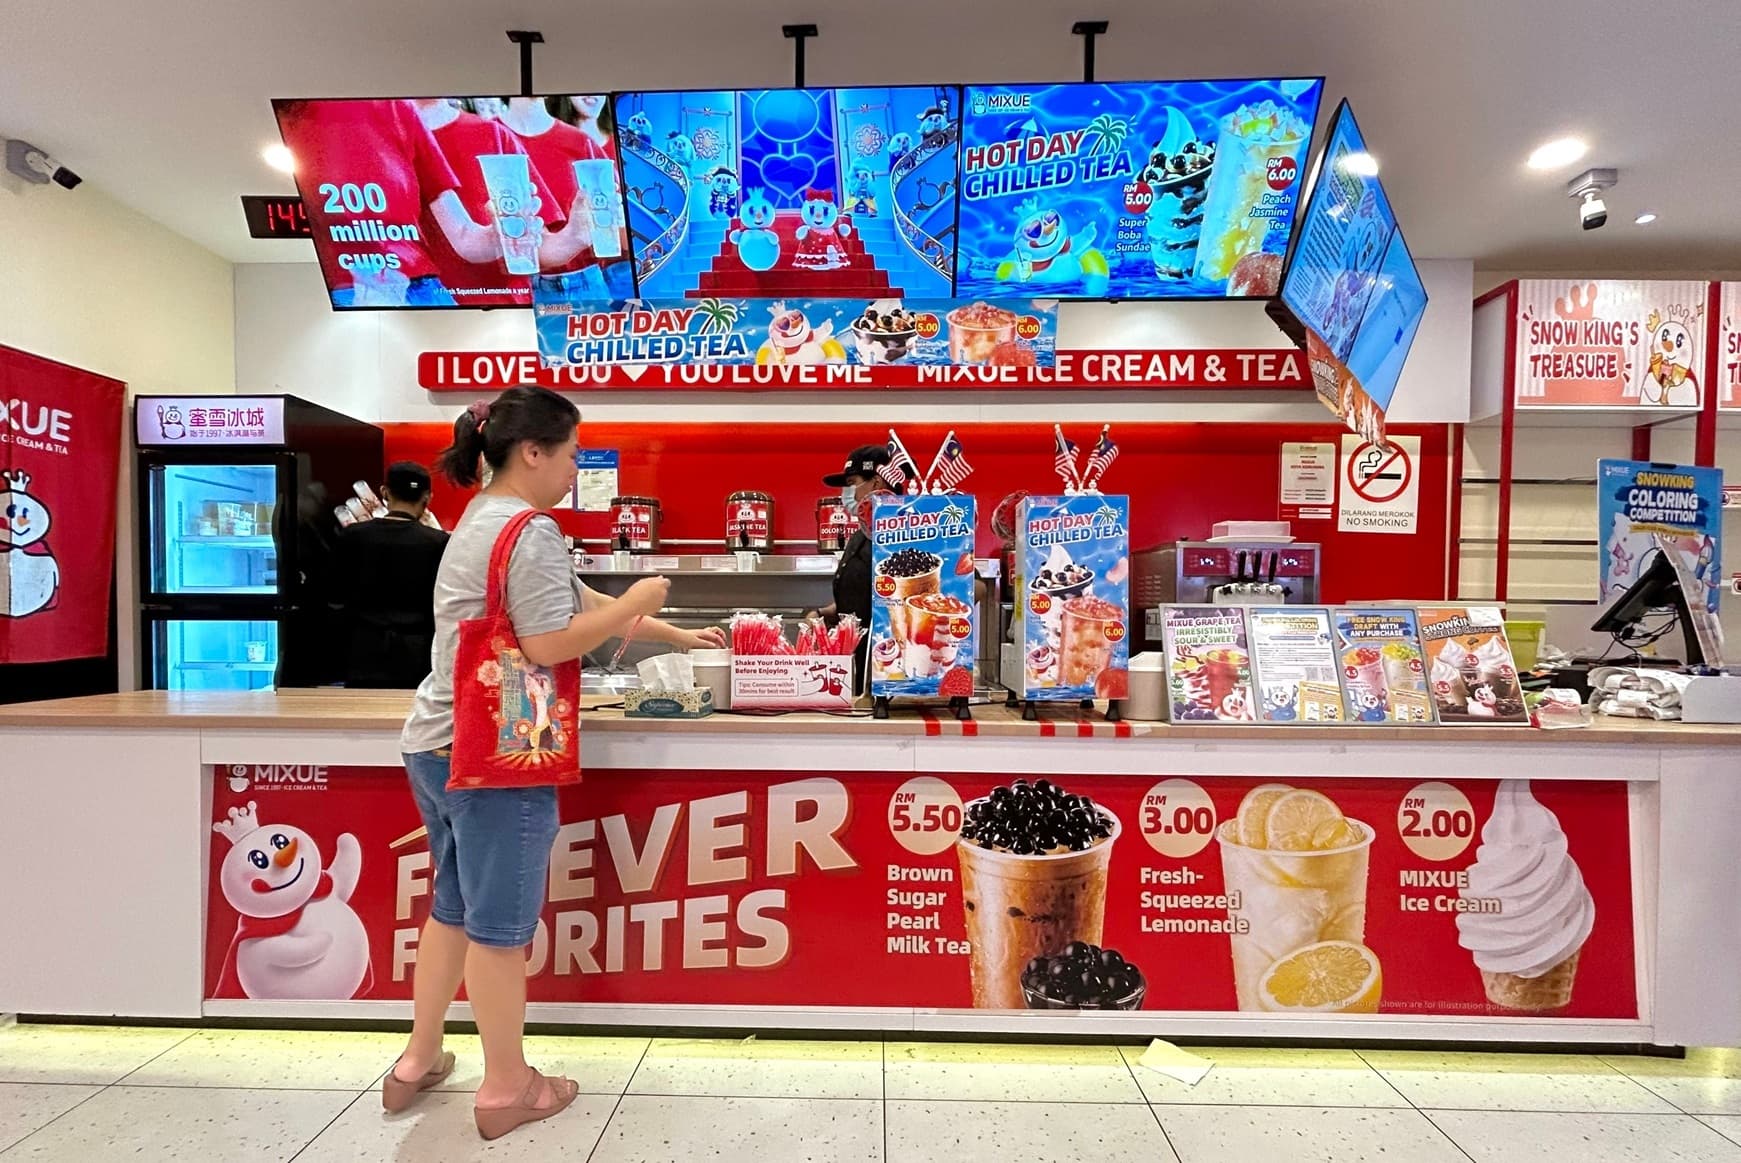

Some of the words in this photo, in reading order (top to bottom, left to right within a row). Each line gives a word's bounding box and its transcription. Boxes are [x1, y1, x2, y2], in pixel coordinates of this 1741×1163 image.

[989, 95, 1030, 107] MIXUE
[966, 140, 1022, 172] HOT
[1025, 130, 1085, 162] DAY
[1267, 158, 1282, 168] RM
[964, 163, 1077, 199] CHILLED
[1079, 153, 1132, 181] TEA
[1268, 169, 1296, 180] 6.00
[1123, 184, 1138, 193] RM
[319, 183, 387, 213] 200
[1125, 193, 1151, 204] 5.00
[1263, 195, 1291, 204] Peach
[1249, 207, 1289, 217] Jasmine
[330, 221, 419, 242] million
[1119, 218, 1147, 228] Super
[1270, 221, 1285, 230] Tea
[1118, 231, 1142, 240] Boba
[1116, 243, 1150, 252] Sundae
[338, 251, 401, 271] cups
[568, 312, 627, 339] HOT
[633, 308, 693, 334] DAY
[917, 323, 938, 332] 5.00
[1018, 325, 1039, 333] 6.00
[1530, 321, 1578, 346] SNOW
[1584, 321, 1640, 346] KING'S
[568, 336, 688, 364] CHILLED
[690, 333, 747, 358] TEA
[437, 356, 444, 384] I
[452, 356, 537, 384] LOVE
[551, 364, 612, 384] YOU
[661, 365, 724, 383] YOU
[732, 365, 818, 384] LOVE
[826, 365, 873, 383] ME
[917, 365, 1018, 383] MIXUE
[1027, 354, 1074, 382] ICE
[1082, 354, 1195, 382] CREAM
[1204, 354, 1227, 382] &
[1237, 353, 1301, 382] TEA
[1530, 354, 1618, 379] TREASURE
[189, 407, 265, 427] 蜜雪冰城
[16, 436, 44, 450] CREAM
[45, 443, 53, 452] &
[54, 444, 69, 455] TEA
[1636, 472, 1695, 489] SNOWKING
[1628, 489, 1698, 510] COLORING
[876, 517, 907, 532] HOT
[910, 512, 941, 528] DAY
[1341, 509, 1378, 518] DILARANG
[1346, 517, 1361, 526] NO
[1363, 518, 1409, 528] SMOKING
[1630, 507, 1697, 523] COMPETITION
[1029, 517, 1060, 533] HOT
[1063, 513, 1094, 529] DAY
[876, 527, 939, 545] CHILLED
[940, 523, 970, 538] TEA
[1029, 528, 1092, 547] CHILLED
[1094, 523, 1123, 539] TEA
[875, 583, 896, 592] 5.50
[1031, 601, 1050, 609] 5.00
[951, 625, 970, 633] 5.00
[1166, 620, 1195, 628] MIXUE
[1196, 618, 1224, 627] GRAPE
[1226, 617, 1241, 626] TEA
[1176, 627, 1233, 636] IRRESISTIBLY
[1422, 616, 1471, 634] SNOWKIN
[1105, 628, 1124, 636] 6.00
[1174, 637, 1198, 645] SOUR
[1207, 635, 1237, 643] SWEET
[254, 764, 328, 783] MIXUE
[895, 793, 915, 803] RM
[1146, 796, 1167, 805] RM
[1405, 798, 1426, 808] RM
[893, 805, 961, 832] 5.50
[1143, 807, 1214, 835] 3.00
[1401, 810, 1473, 838] 2.00
[396, 777, 858, 921] FEVER
[887, 865, 953, 882] Brown
[1140, 867, 1204, 885] Fresh-
[1400, 870, 1469, 888] MIXUE
[887, 889, 947, 909] Sugar
[1140, 890, 1241, 912] Squeezed
[1400, 894, 1429, 912] Ice
[1435, 895, 1501, 914] Cream
[887, 912, 940, 930] Pearl
[1140, 916, 1250, 935] Lemonade
[392, 889, 790, 983] FRITES
[887, 936, 930, 954] Milk
[935, 937, 972, 955] Tea
[1381, 1000, 1407, 1008] shown
[1438, 1001, 1484, 1010] illustration
